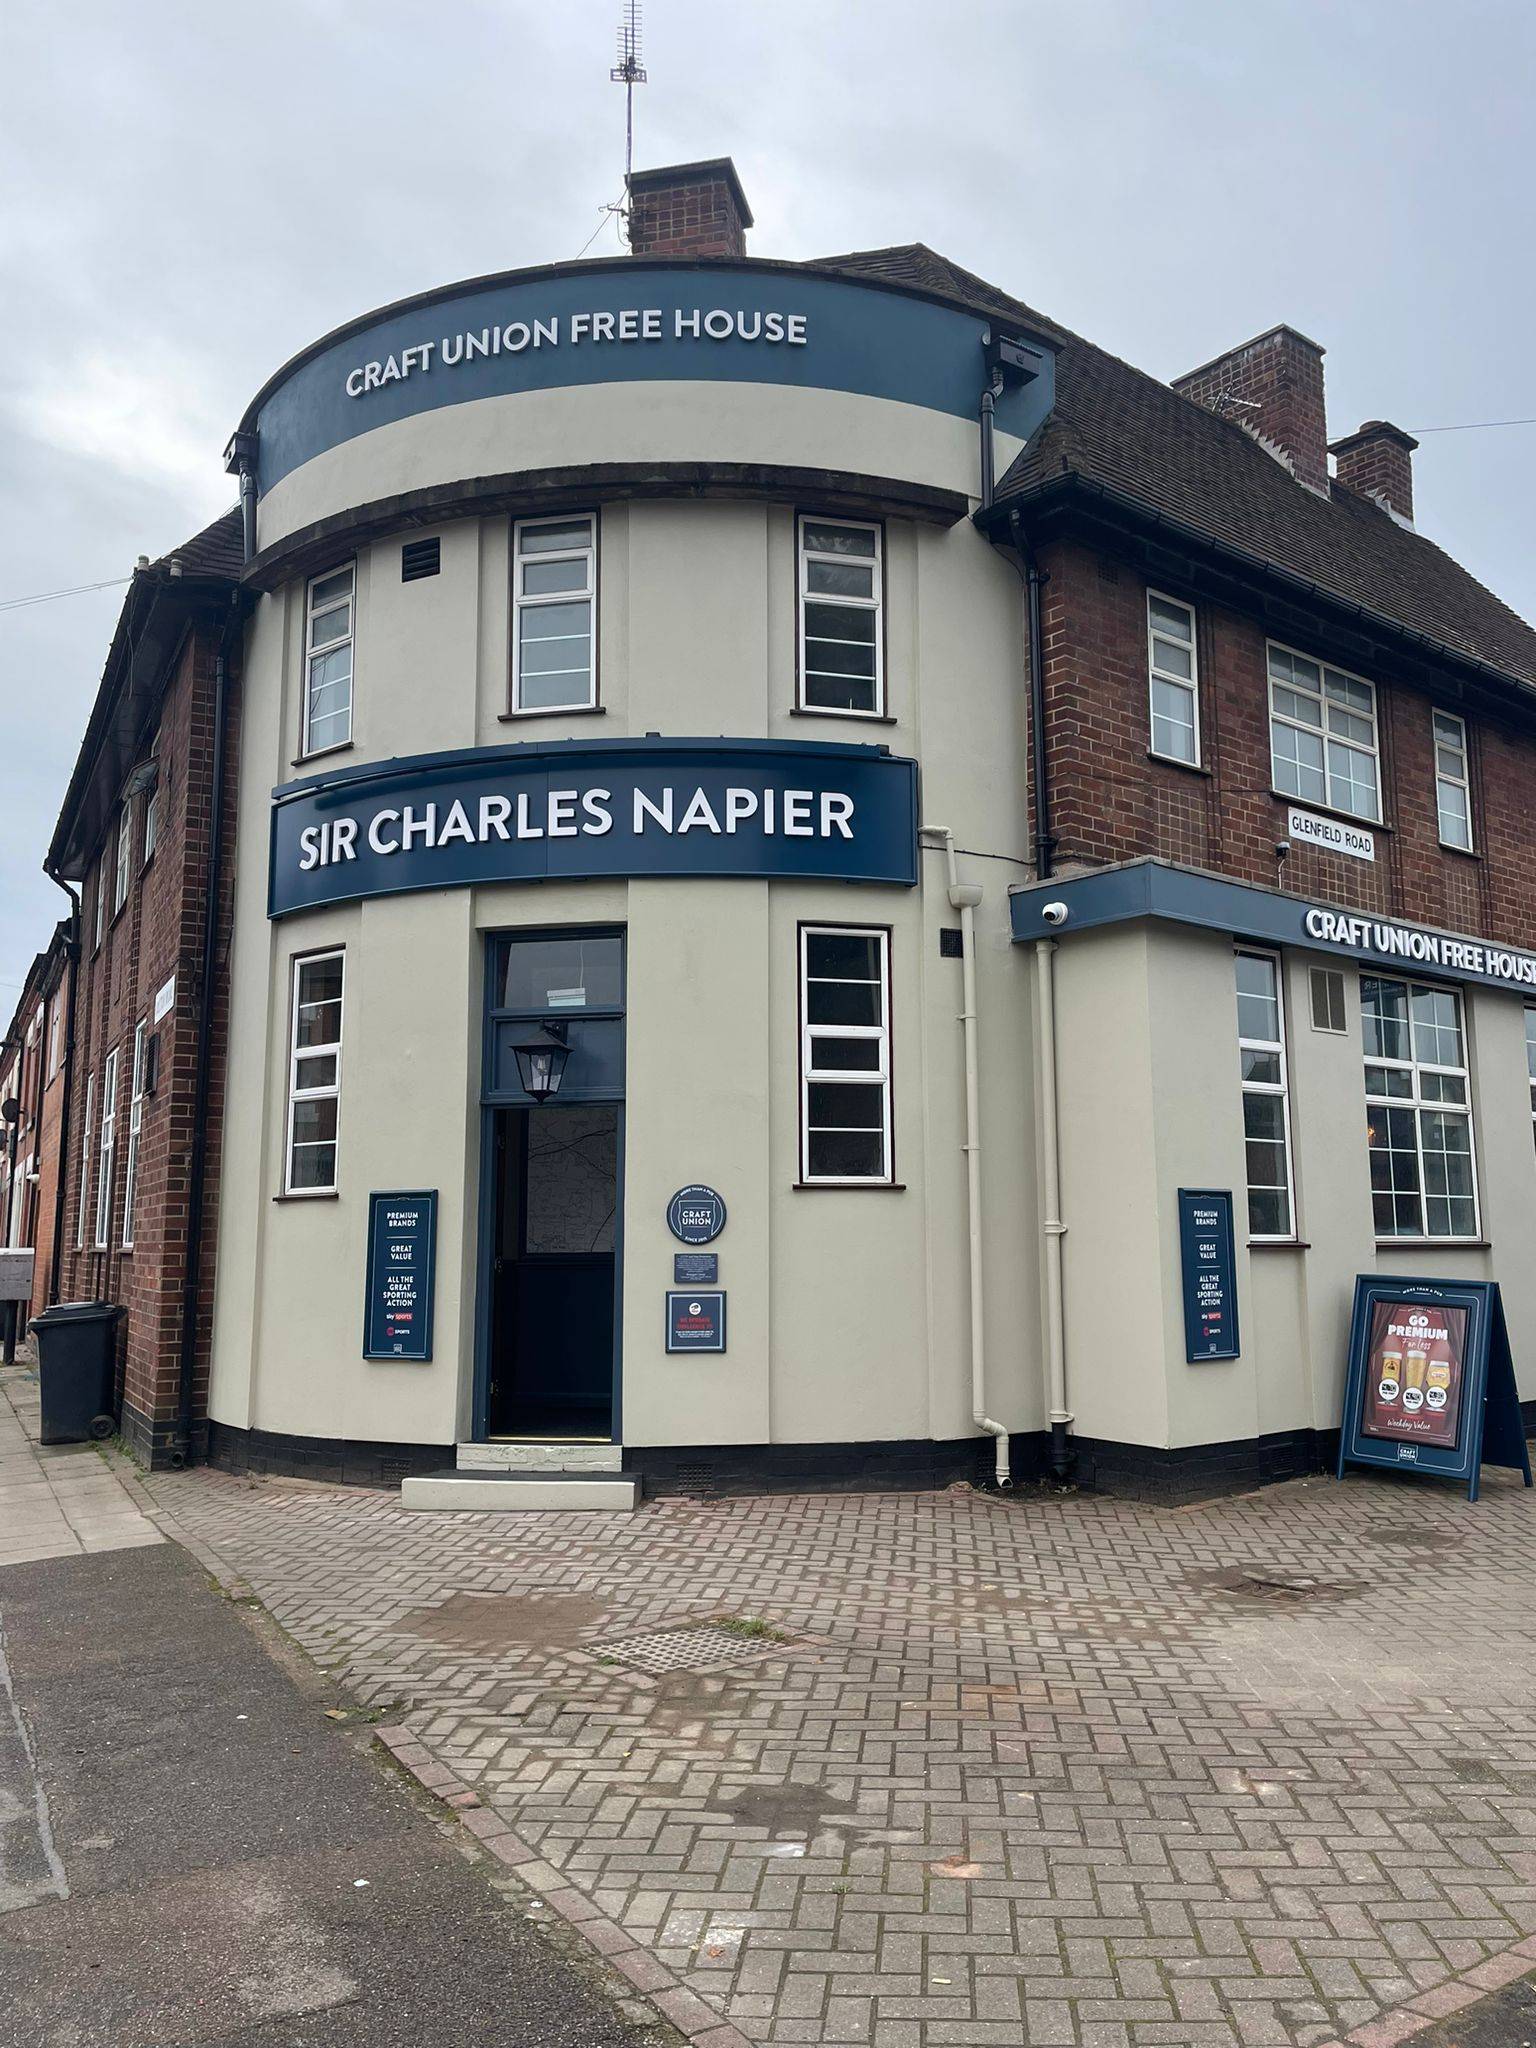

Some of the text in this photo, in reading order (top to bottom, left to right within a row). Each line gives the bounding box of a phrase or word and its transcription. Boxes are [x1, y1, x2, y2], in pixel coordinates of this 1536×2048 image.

[345, 309, 807, 398] CRAFT UNION FREE HOUSE
[299, 787, 856, 870] SIR CHARLES NAPIER
[1292, 815, 1371, 853] GLENFIELD ROAD
[1305, 909, 1536, 984] CRAFT UNION FREE HOUSE
[682, 1210, 711, 1218] CRAFT
[1193, 1210, 1218, 1218] PREMIUM
[1196, 1218, 1217, 1226] BRANDS
[383, 1291, 417, 1299] SPORTING
[1408, 1315, 1429, 1327] GO
[1388, 1324, 1448, 1340] PREMIUM
